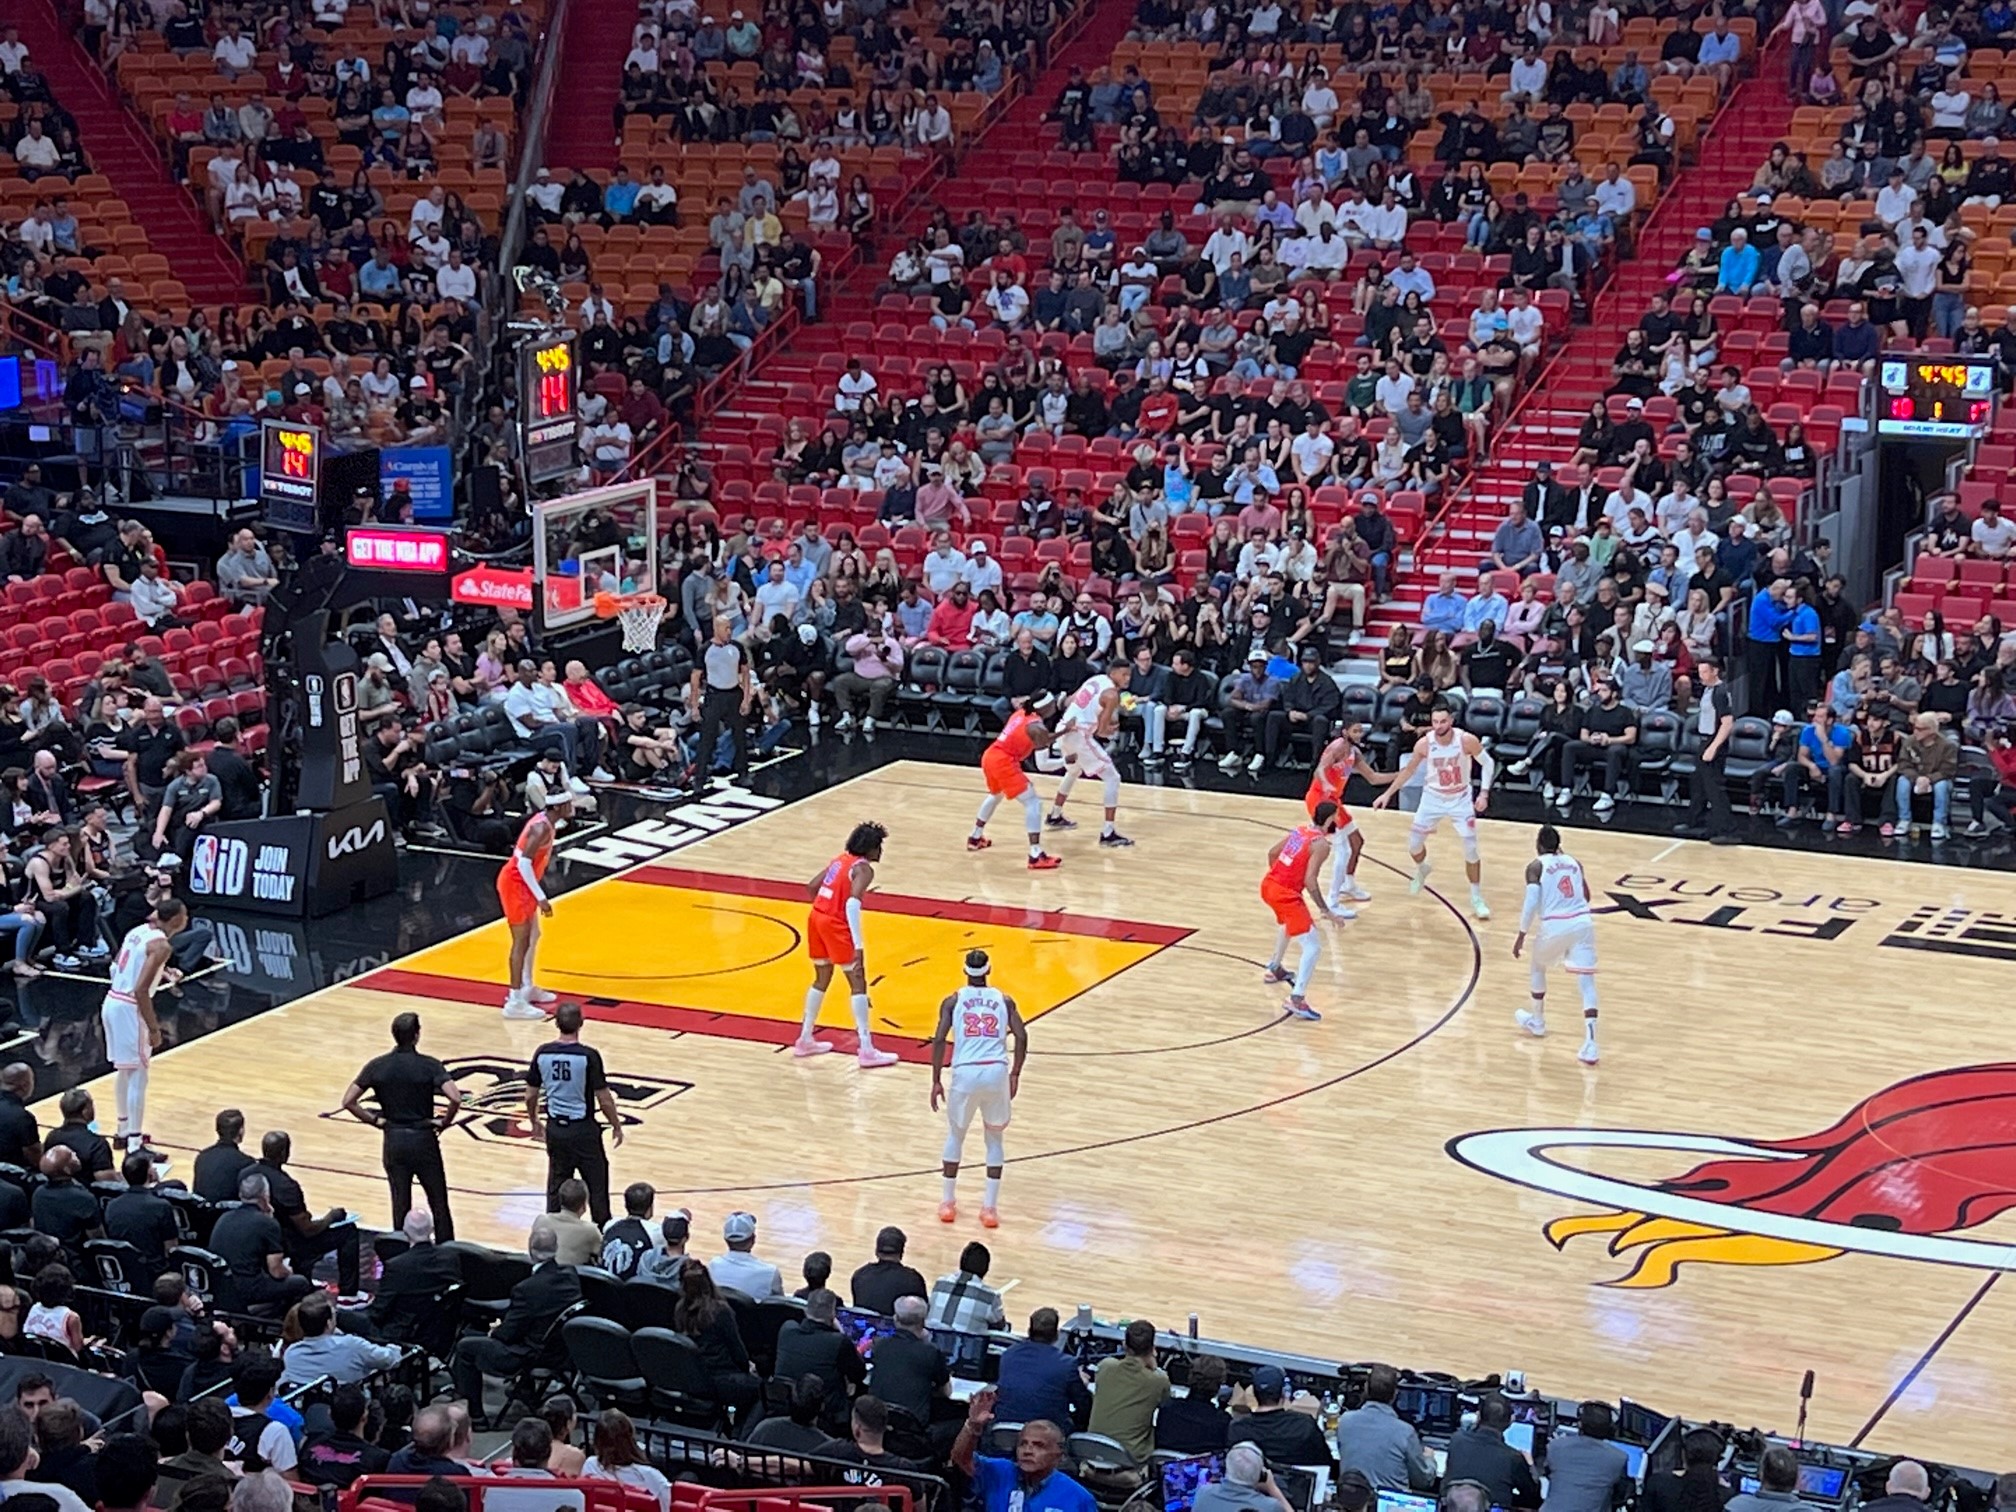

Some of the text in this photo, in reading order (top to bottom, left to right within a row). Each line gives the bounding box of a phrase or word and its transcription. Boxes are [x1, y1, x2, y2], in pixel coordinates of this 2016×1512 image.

[536, 343, 570, 373] 4:45
[1918, 365, 1967, 387] 4:45
[541, 373, 568, 416] 14
[279, 430, 314, 455] 4:45
[283, 452, 306, 478] 14
[352, 537, 441, 565] GET THE NBA APP
[480, 581, 532, 602] State Fa
[558, 775, 785, 869] HEAT
[254, 845, 289, 873] JOIN
[252, 872, 295, 901] TODAY
[1615, 873, 1882, 913] arena
[1590, 891, 1857, 940] FTX
[963, 1012, 999, 1038] 22
[552, 1060, 571, 1082] 36
